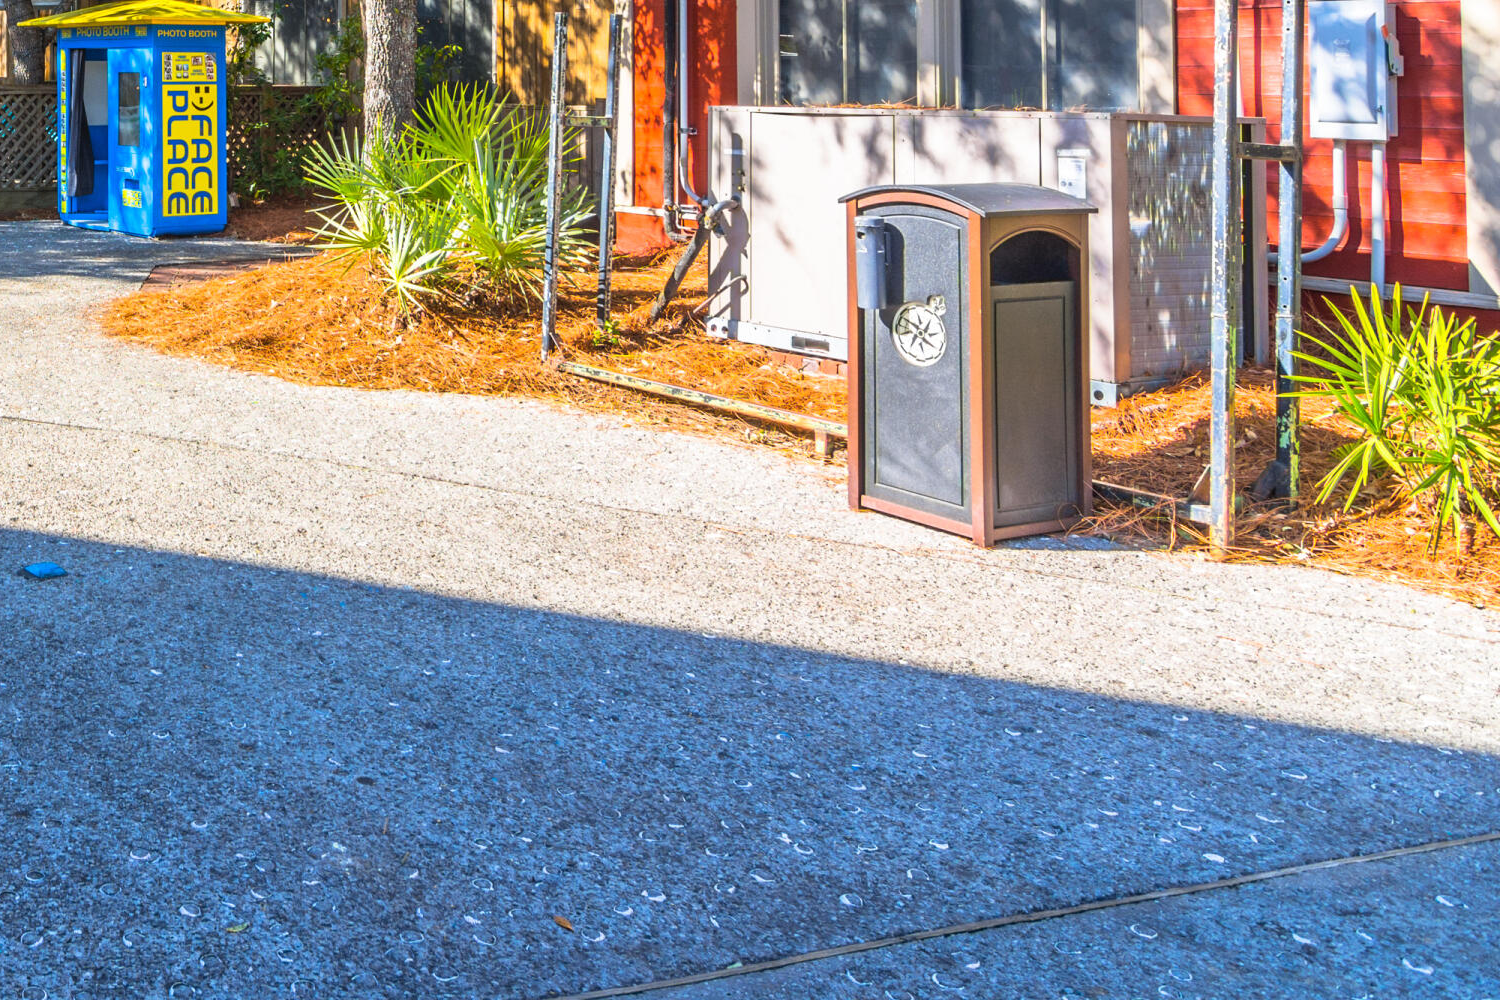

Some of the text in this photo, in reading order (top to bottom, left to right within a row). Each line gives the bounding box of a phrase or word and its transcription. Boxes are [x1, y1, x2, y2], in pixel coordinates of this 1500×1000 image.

[76, 27, 100, 37] PHOTO
[103, 26, 130, 37] BOOTH
[157, 29, 186, 38] PHOTO
[188, 29, 218, 38] BOOTH
[167, 90, 189, 214] PLACE
[191, 114, 213, 214] FACE
